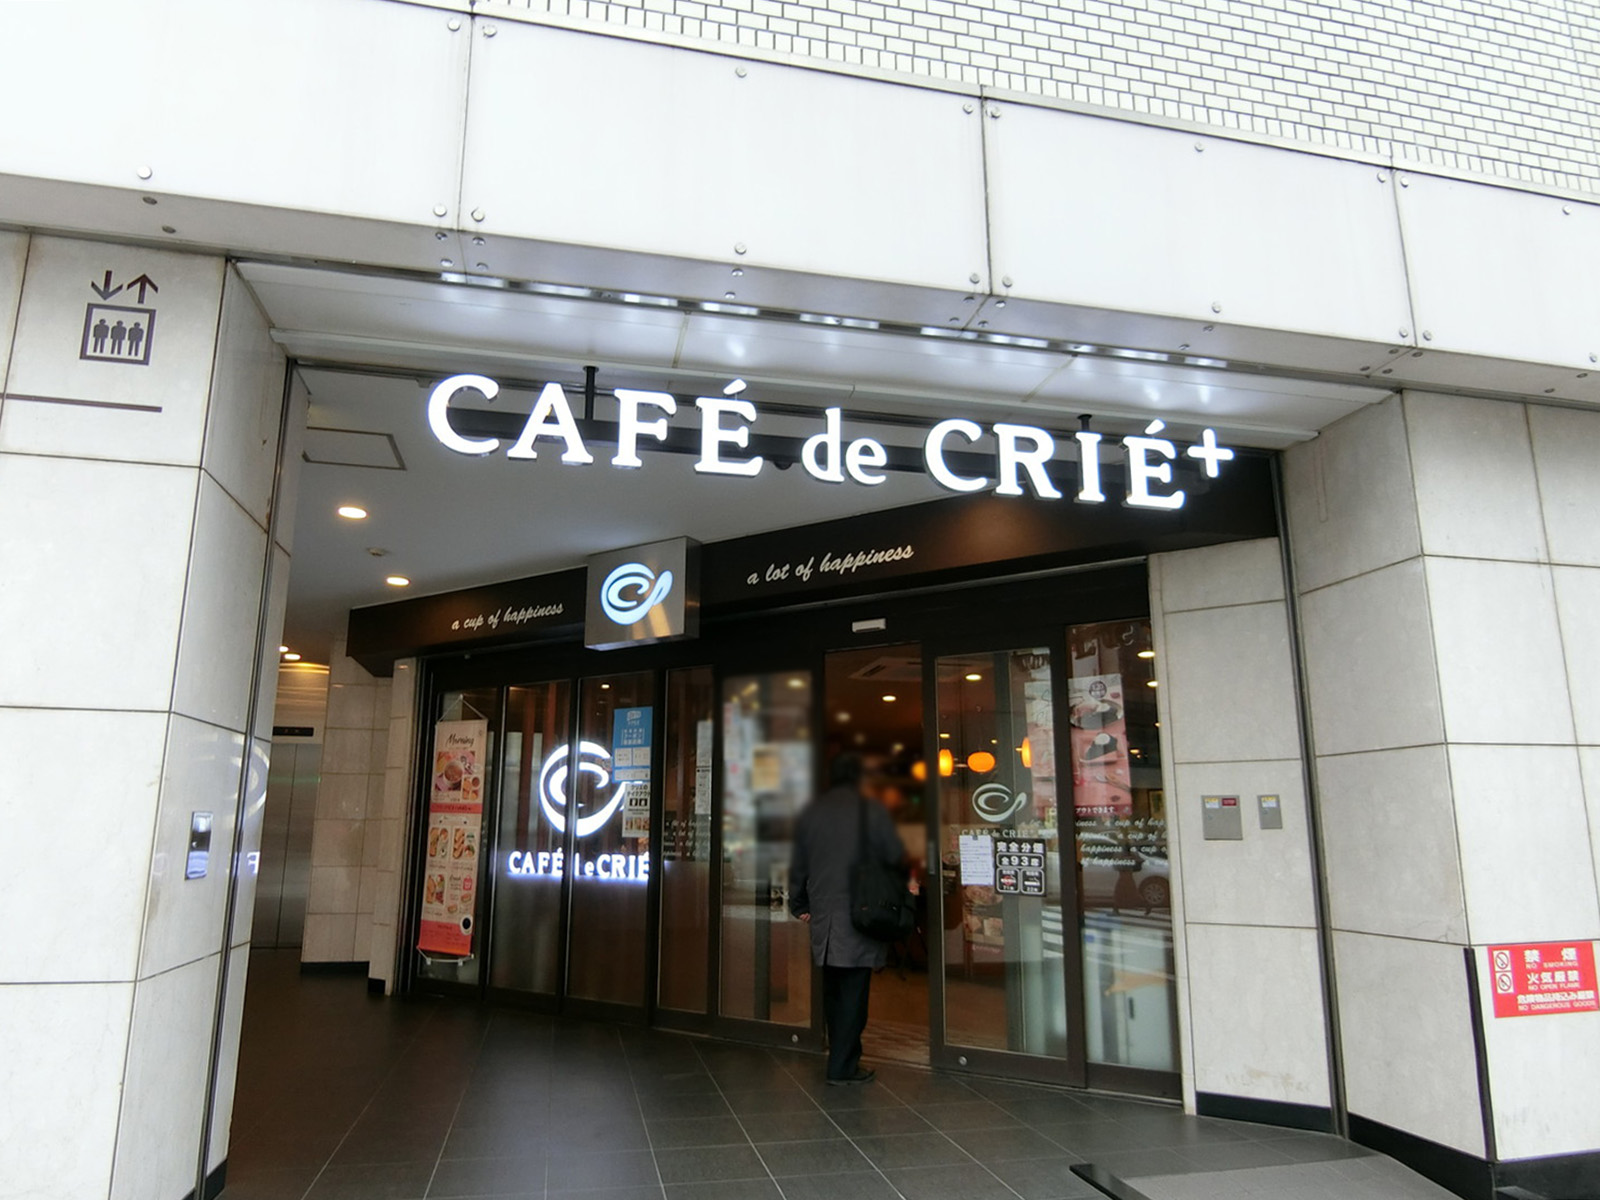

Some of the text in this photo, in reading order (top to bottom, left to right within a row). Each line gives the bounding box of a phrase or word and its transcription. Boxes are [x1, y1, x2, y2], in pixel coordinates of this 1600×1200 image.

[428, 374, 764, 477] CAFÉ
[801, 407, 888, 486] de
[747, 545, 914, 585] a lot of happiness
[451, 603, 564, 631] a cup of happiness
[445, 733, 475, 747] Morning
[508, 847, 563, 877] CAFÉ
